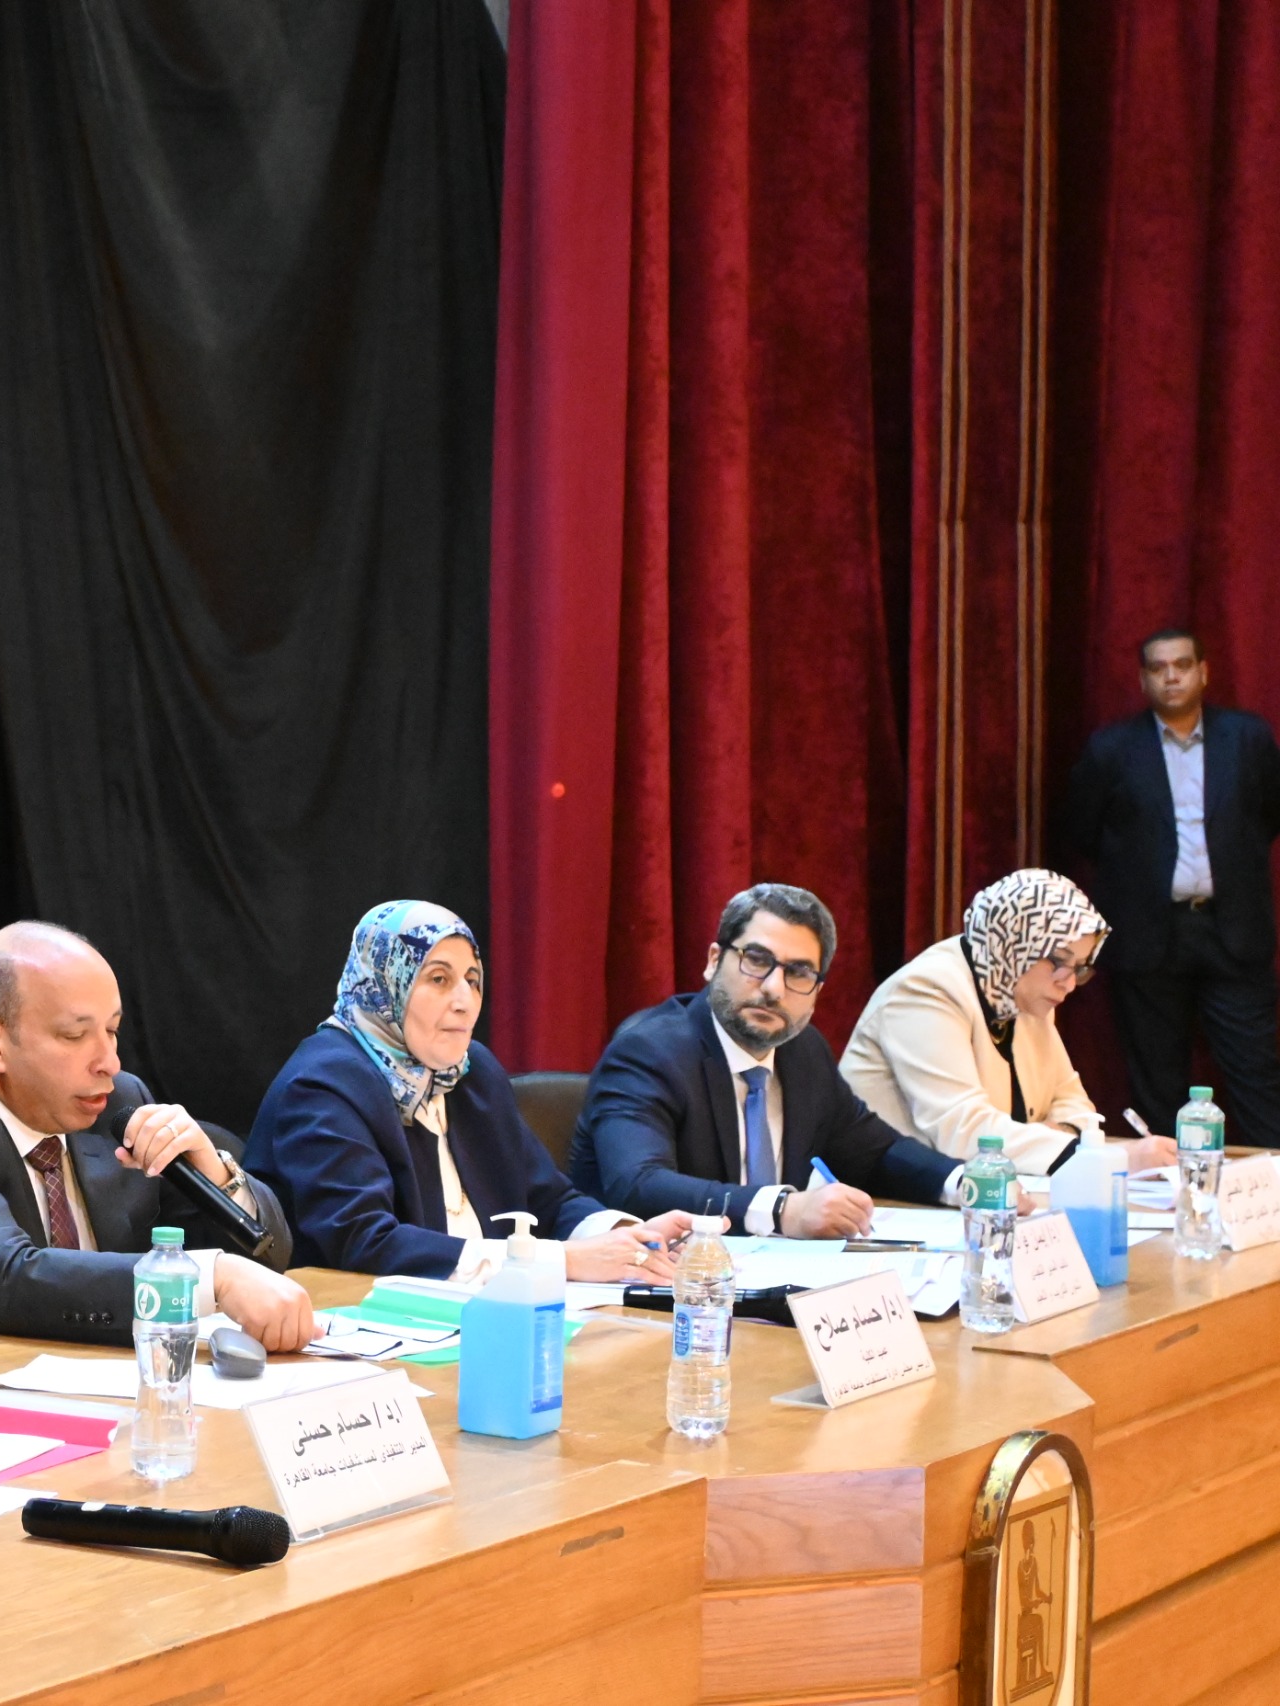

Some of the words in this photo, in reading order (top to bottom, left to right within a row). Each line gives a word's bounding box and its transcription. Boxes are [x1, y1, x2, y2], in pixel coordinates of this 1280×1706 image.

[814, 1312, 850, 1352] صلاح
[853, 1305, 883, 1340] حسام
[293, 1421, 333, 1457] حسنى
[337, 1412, 372, 1445] حسام
[409, 1436, 428, 1456] المدير
[285, 1468, 313, 1488] القاهرة
[312, 1464, 337, 1477] جامعة
